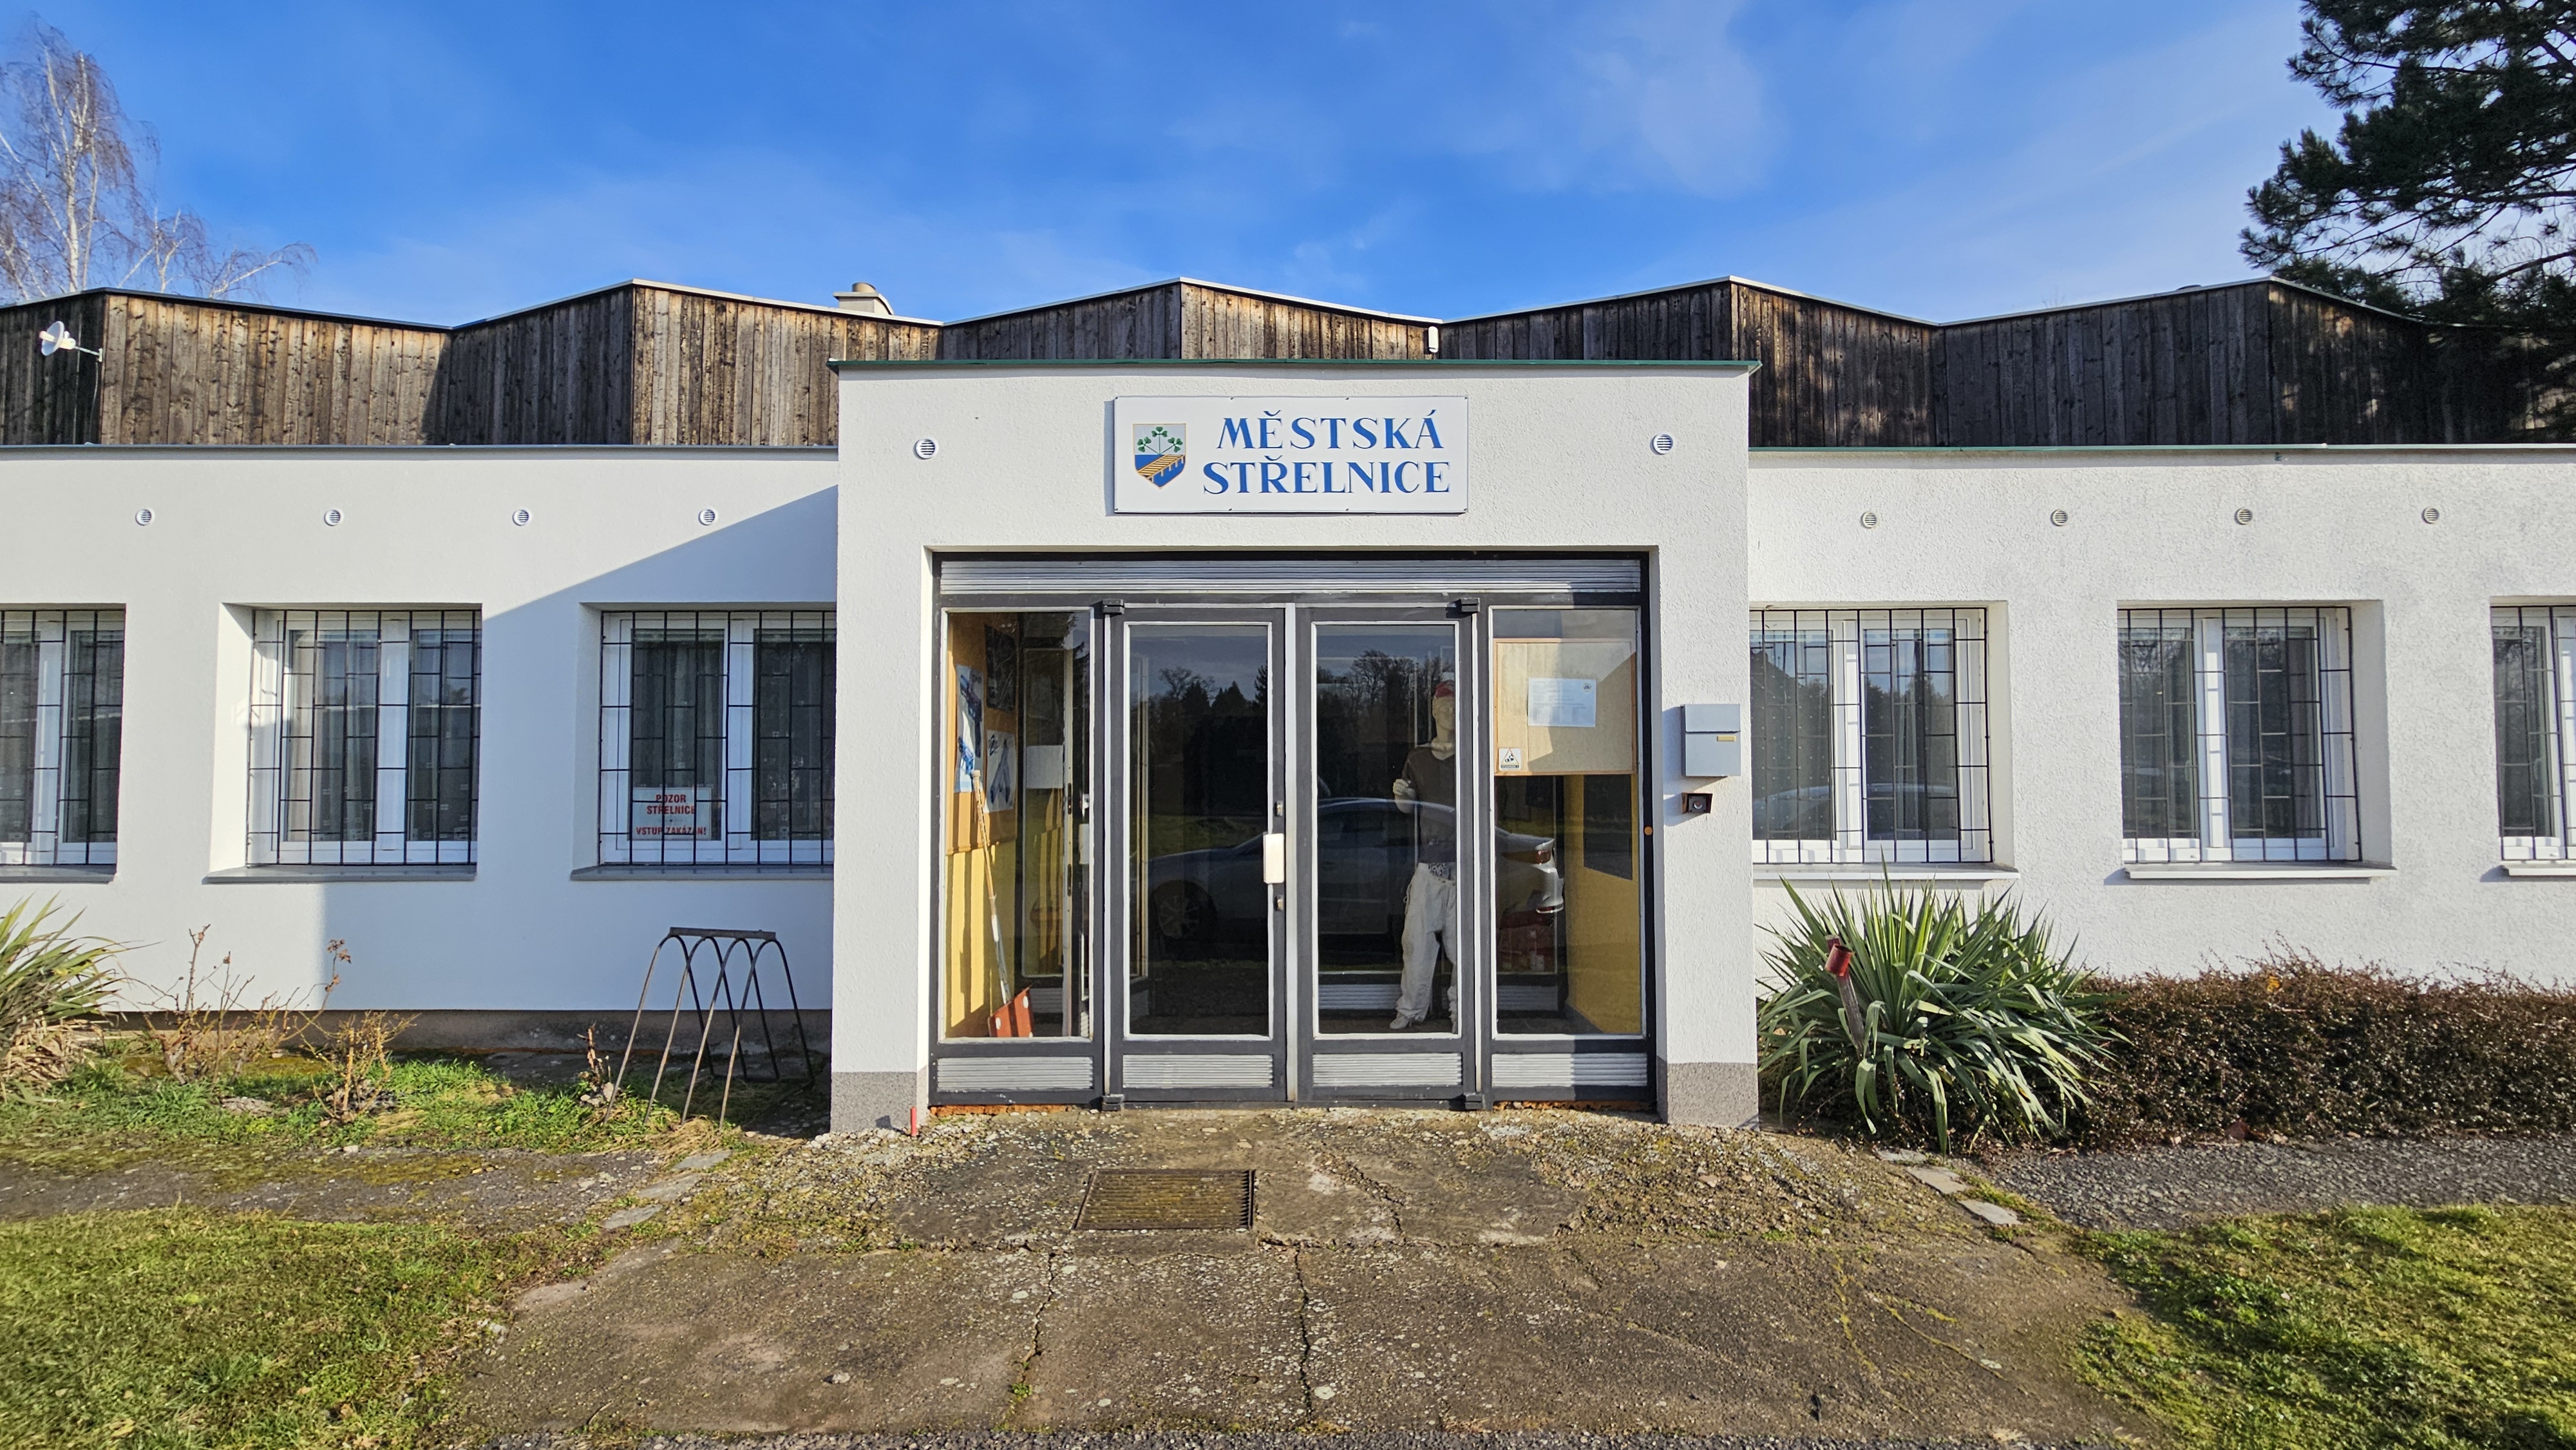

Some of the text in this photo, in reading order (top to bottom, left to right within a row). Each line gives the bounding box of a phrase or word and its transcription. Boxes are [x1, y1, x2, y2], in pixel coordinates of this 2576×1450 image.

[1216, 410, 1444, 450] MĚSTSKÁ
[1202, 455, 1451, 494] STŘELNICE
[656, 794, 687, 803] POZOR
[636, 827, 663, 835] VSTUP
